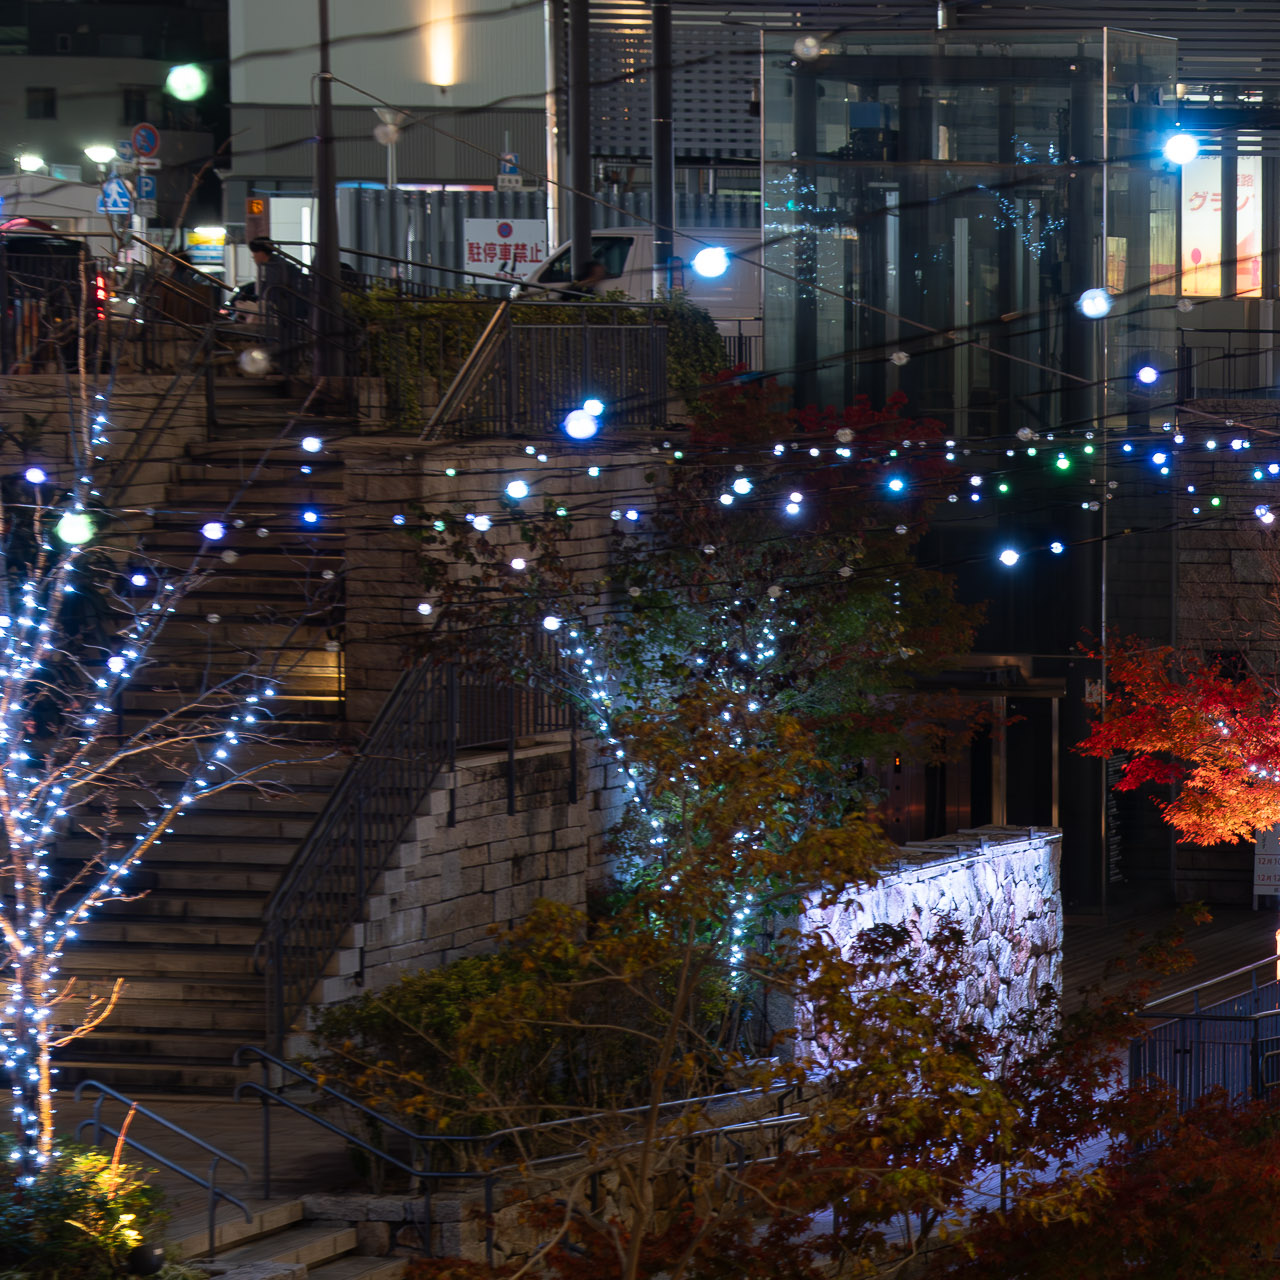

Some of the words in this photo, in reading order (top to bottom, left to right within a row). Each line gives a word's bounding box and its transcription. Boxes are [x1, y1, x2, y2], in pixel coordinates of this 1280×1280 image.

[140, 178, 153, 197] P
[467, 241, 543, 264] 駐停車禁止
